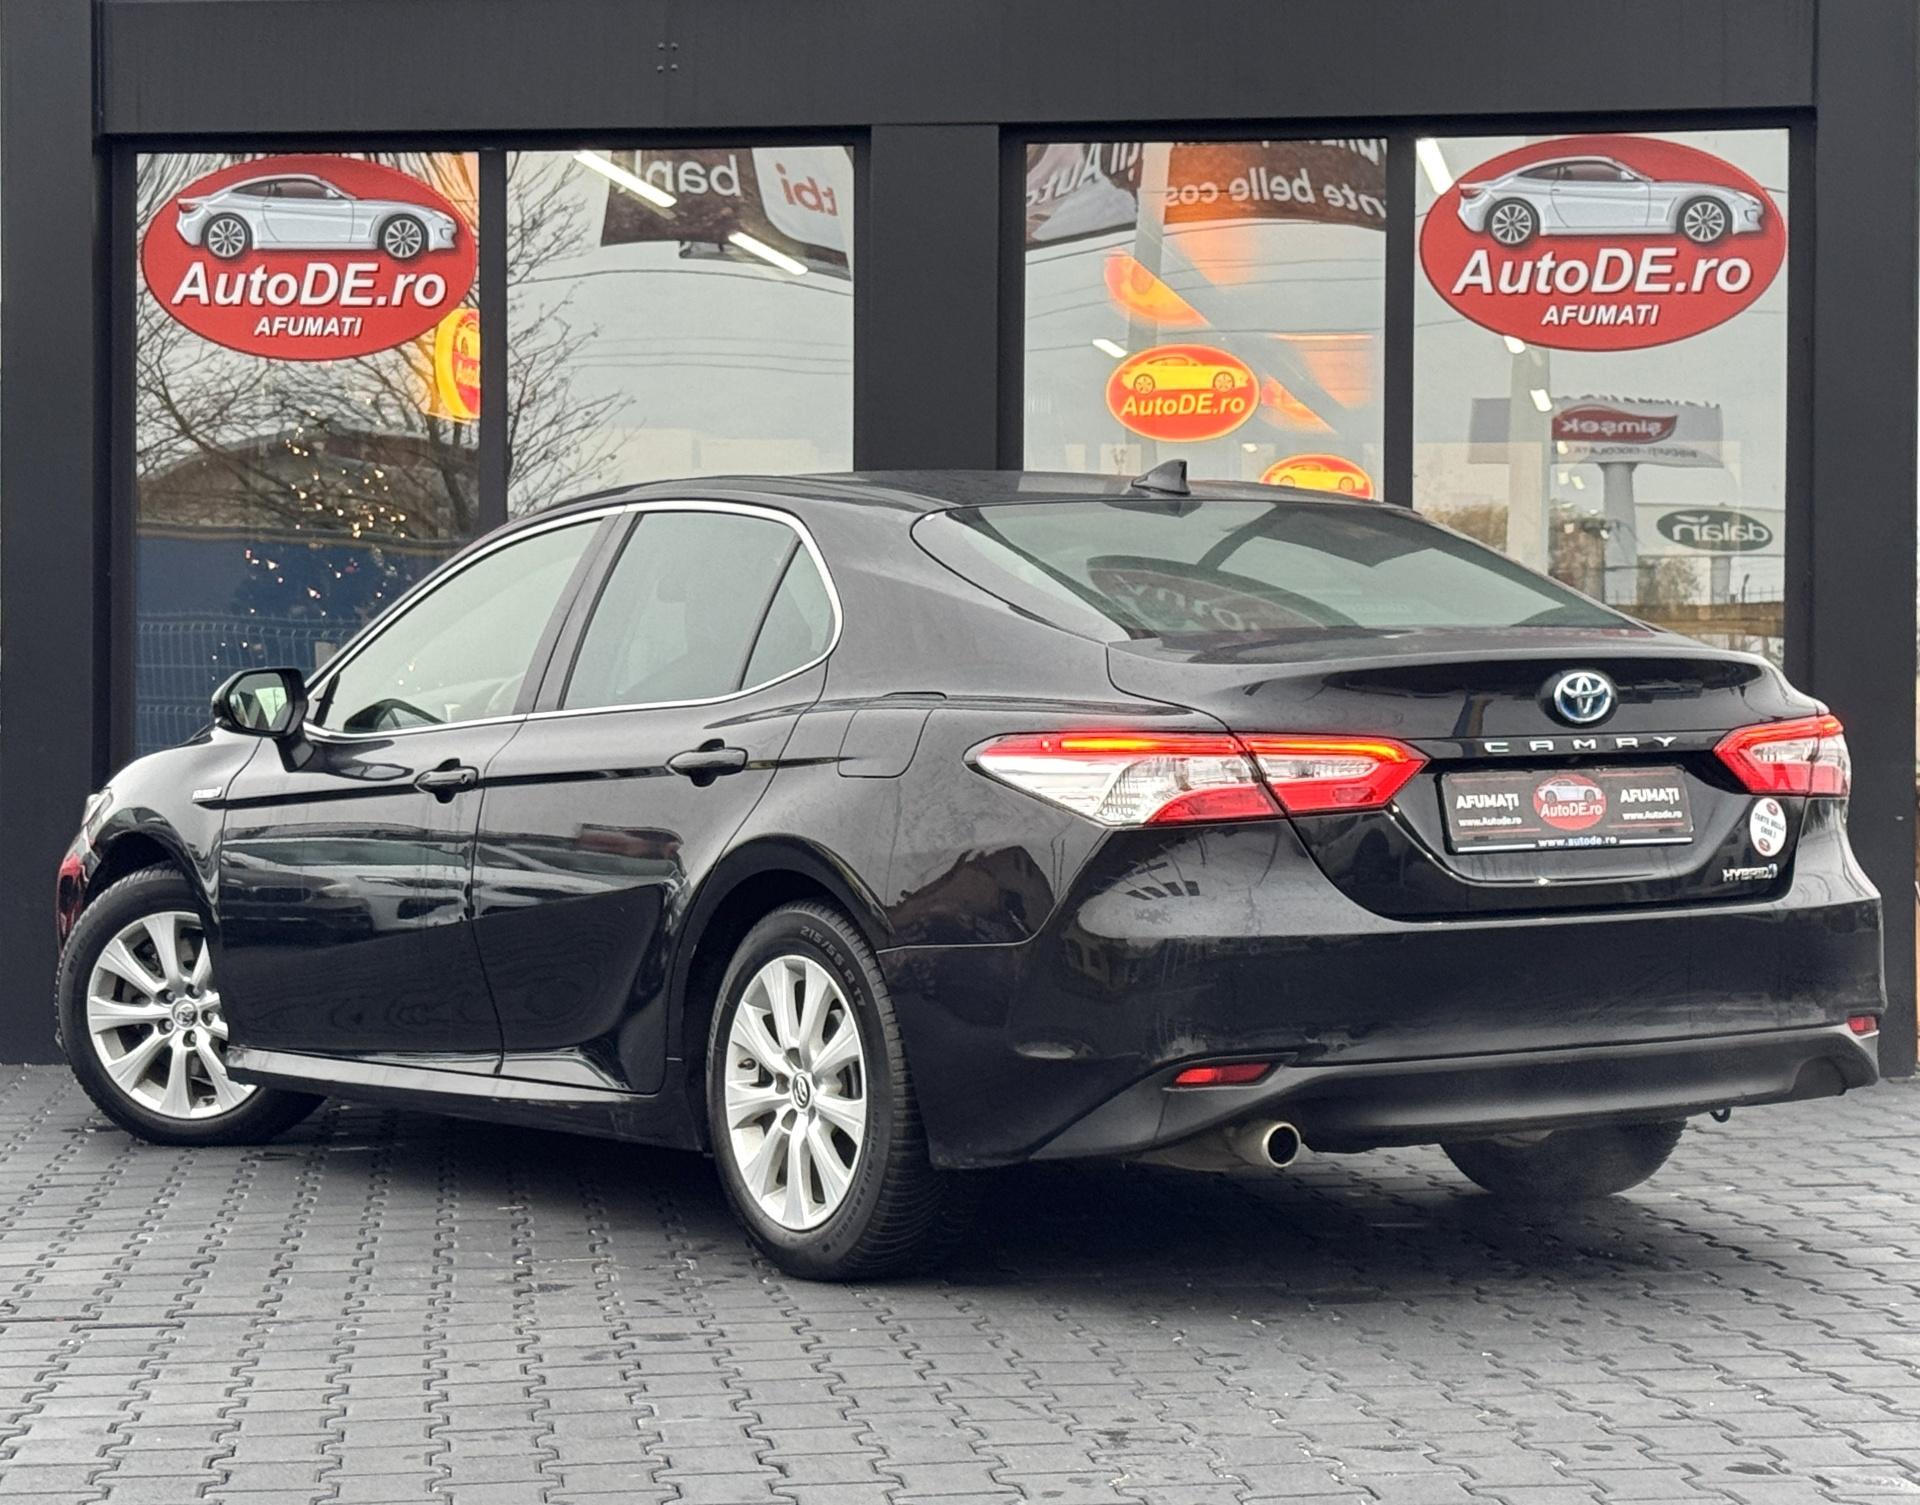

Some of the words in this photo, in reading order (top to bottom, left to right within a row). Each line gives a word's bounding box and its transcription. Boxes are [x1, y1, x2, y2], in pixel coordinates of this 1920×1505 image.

[1451, 247, 1752, 295] AutoDE.ro
[171, 261, 447, 307] AutoDE.ro
[1541, 304, 1660, 326] AFUMATI
[254, 317, 362, 337] AFUMATI
[1120, 392, 1245, 417] AutoDE.ro
[1484, 736, 1677, 753] CAMRY
[1540, 803, 1603, 817] AutoDE.ro
[1538, 836, 1617, 847] www.autode.ro
[1722, 866, 1769, 882] HYBRID
